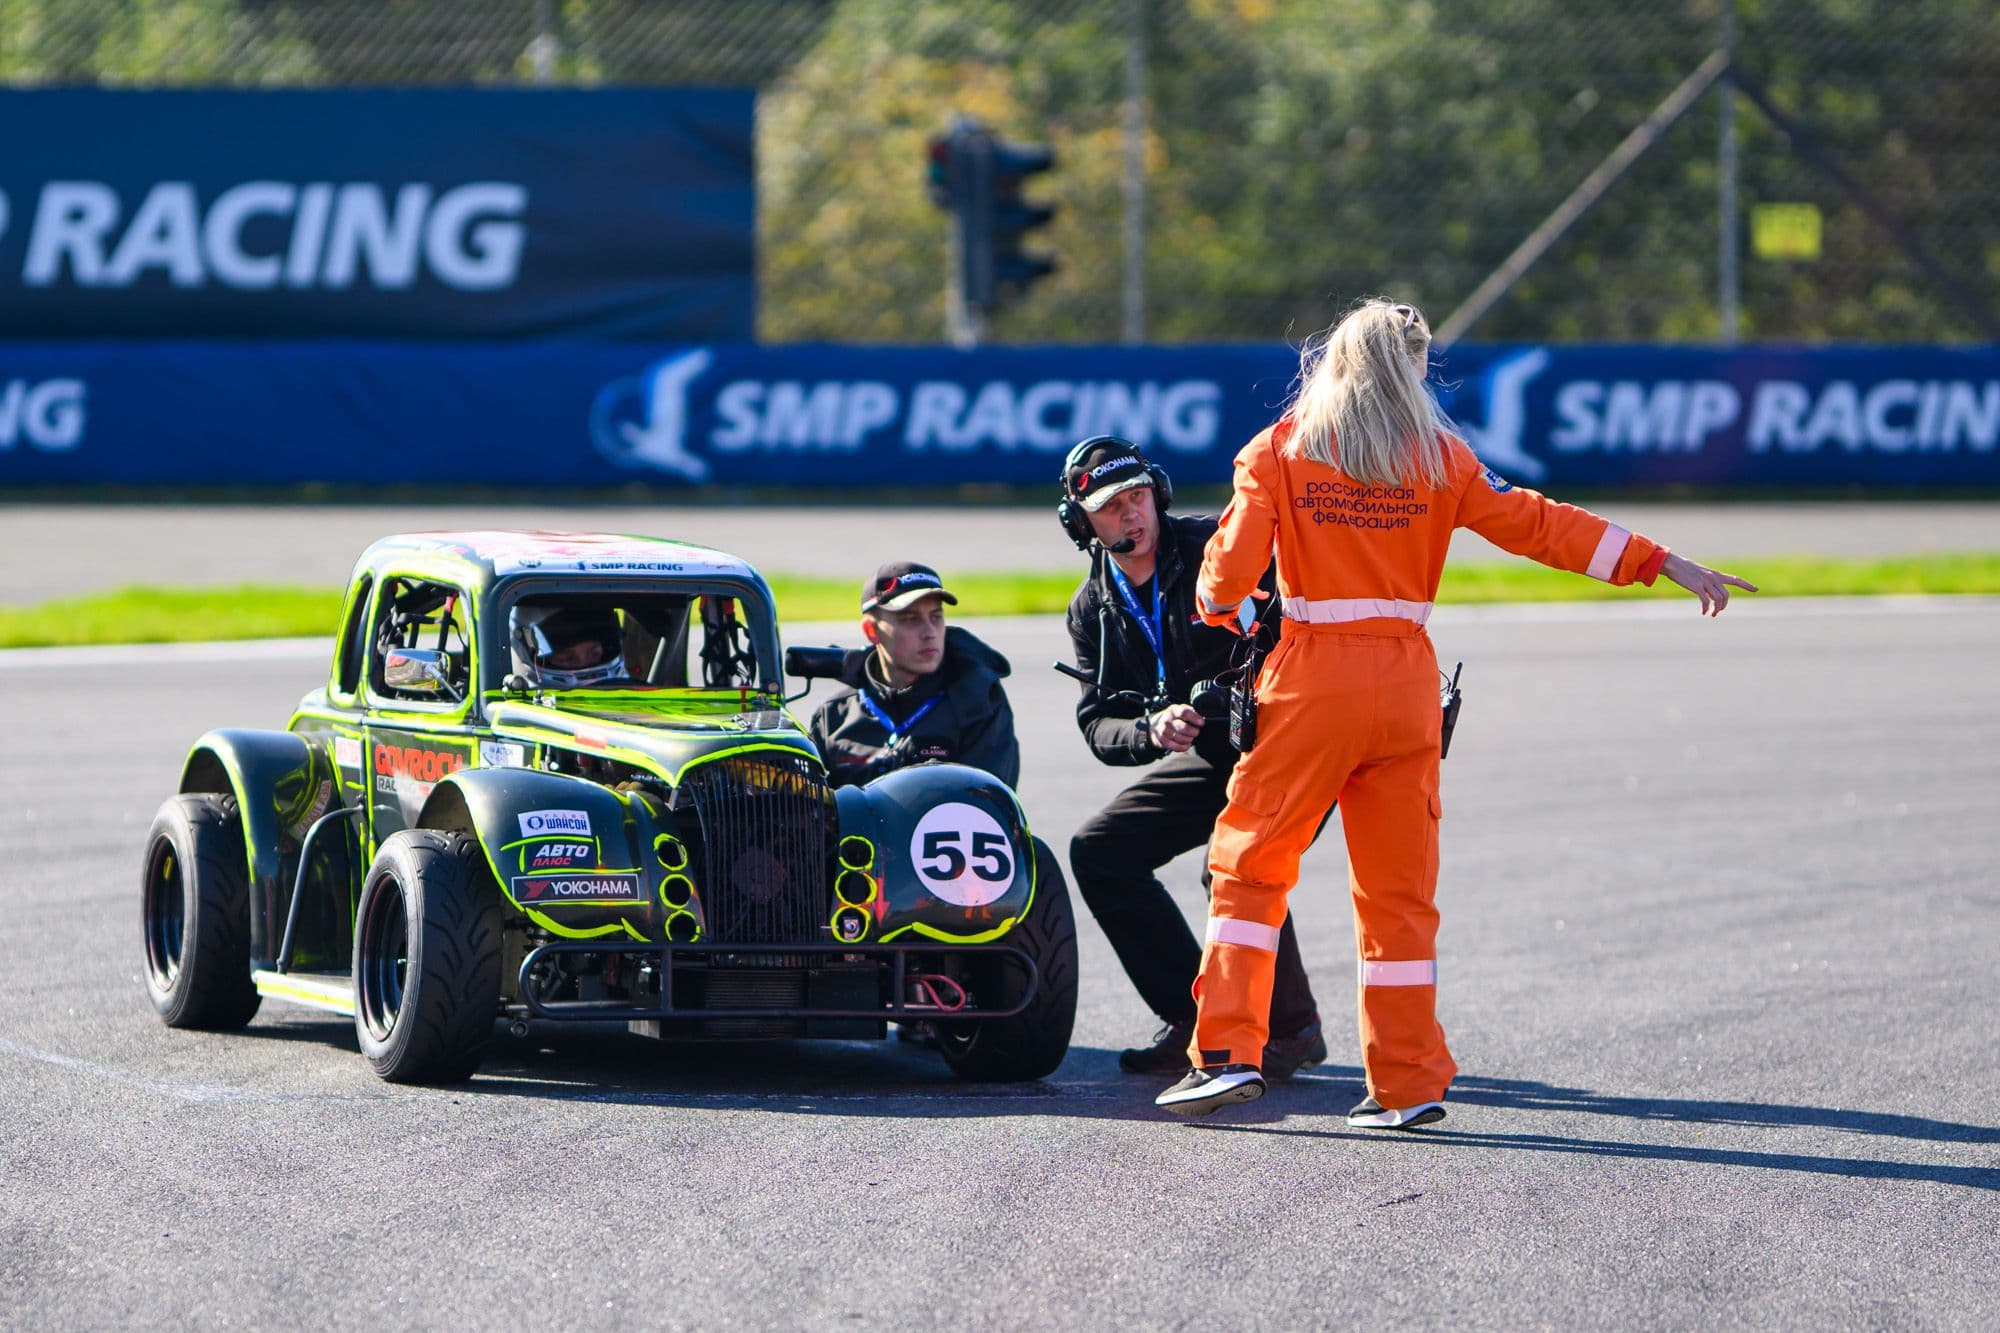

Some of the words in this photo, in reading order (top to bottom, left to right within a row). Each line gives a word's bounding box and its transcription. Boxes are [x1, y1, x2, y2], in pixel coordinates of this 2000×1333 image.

[22, 180, 530, 290] RACING
[711, 380, 898, 451] SMP
[903, 380, 1220, 451] RACING
[1549, 380, 1741, 452] SMP
[1089, 455, 1139, 479] YOKOHAMA
[1294, 496, 1427, 515] автомобильная
[1312, 508, 1409, 529] федерация
[591, 562, 624, 570] SMP
[627, 562, 683, 571] RACING
[545, 817, 588, 831] ШАНСОН
[536, 844, 589, 857] АВТО
[921, 831, 1011, 882] 55
[532, 857, 572, 867] ПЛЮС
[551, 880, 631, 895] YOKOHAMA
